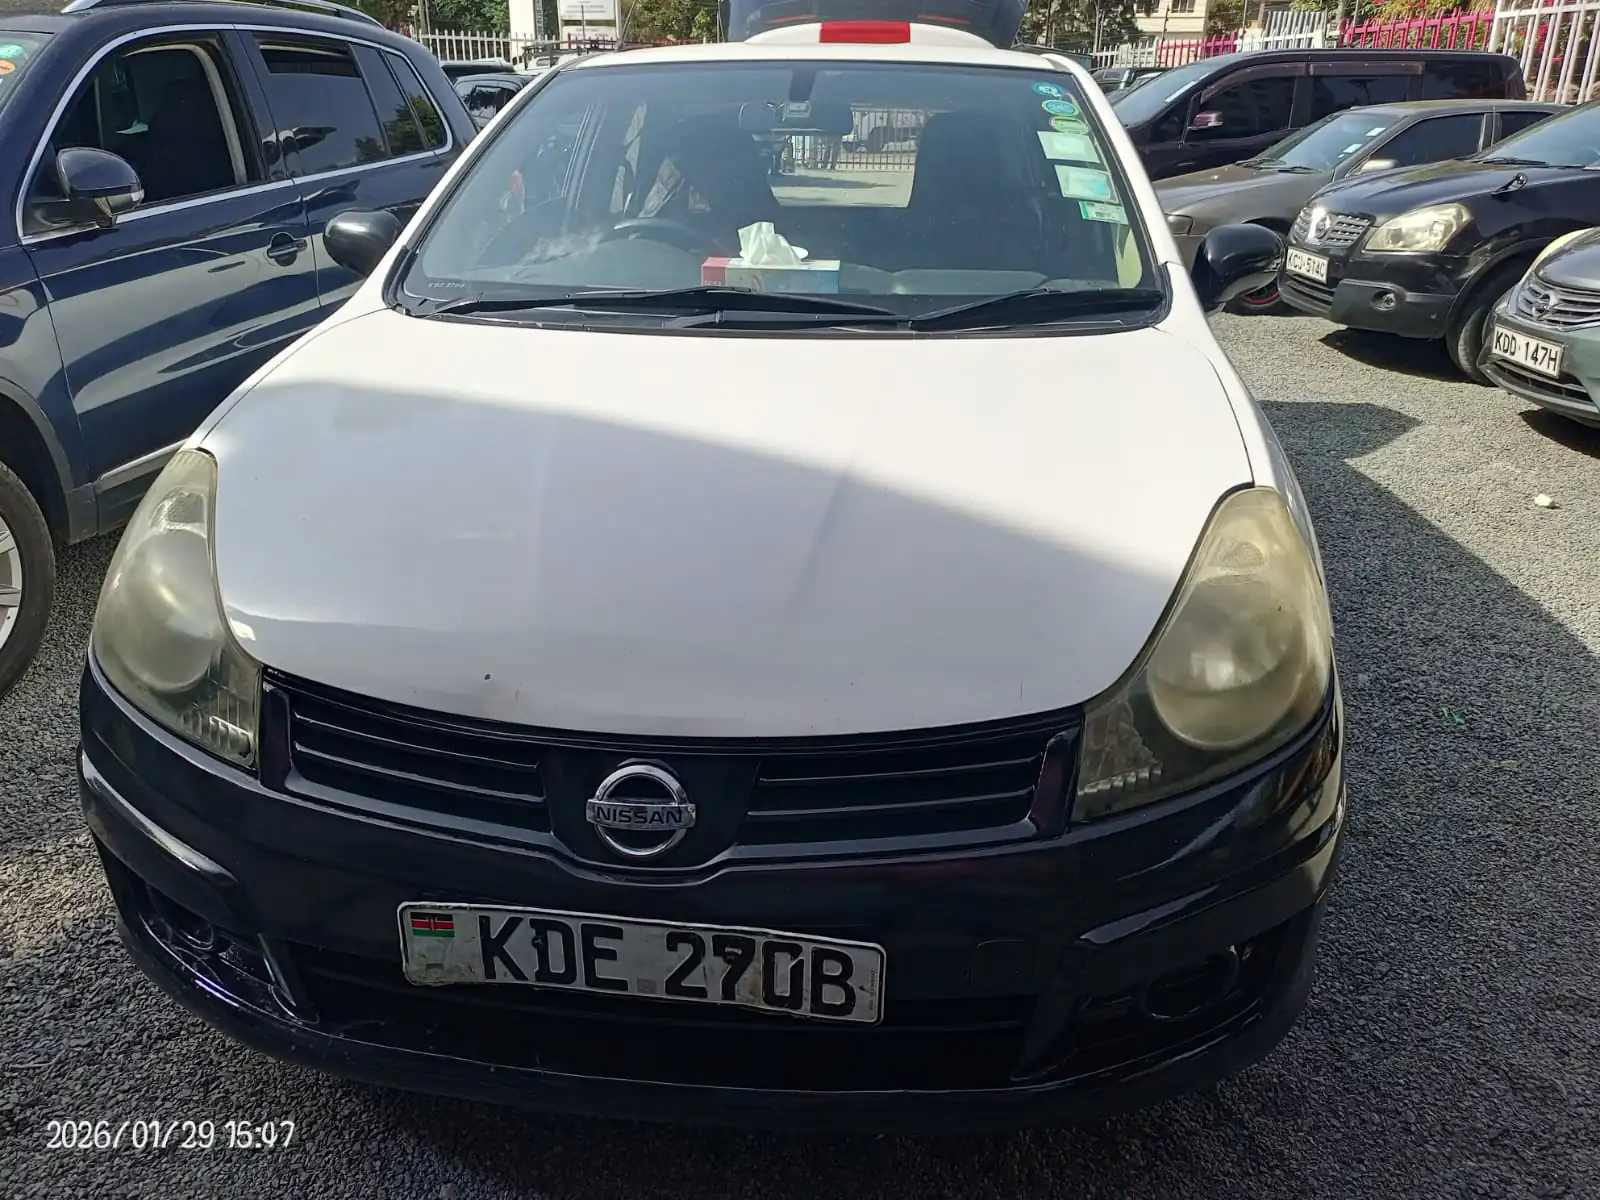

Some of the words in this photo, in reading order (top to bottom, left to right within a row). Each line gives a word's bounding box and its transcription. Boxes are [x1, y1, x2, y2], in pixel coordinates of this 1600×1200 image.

[1495, 330, 1517, 356] KDD
[1525, 341, 1558, 372] 147H
[596, 806, 683, 825] NISSAN
[478, 914, 629, 993] KDE
[664, 930, 856, 1016] 270B
